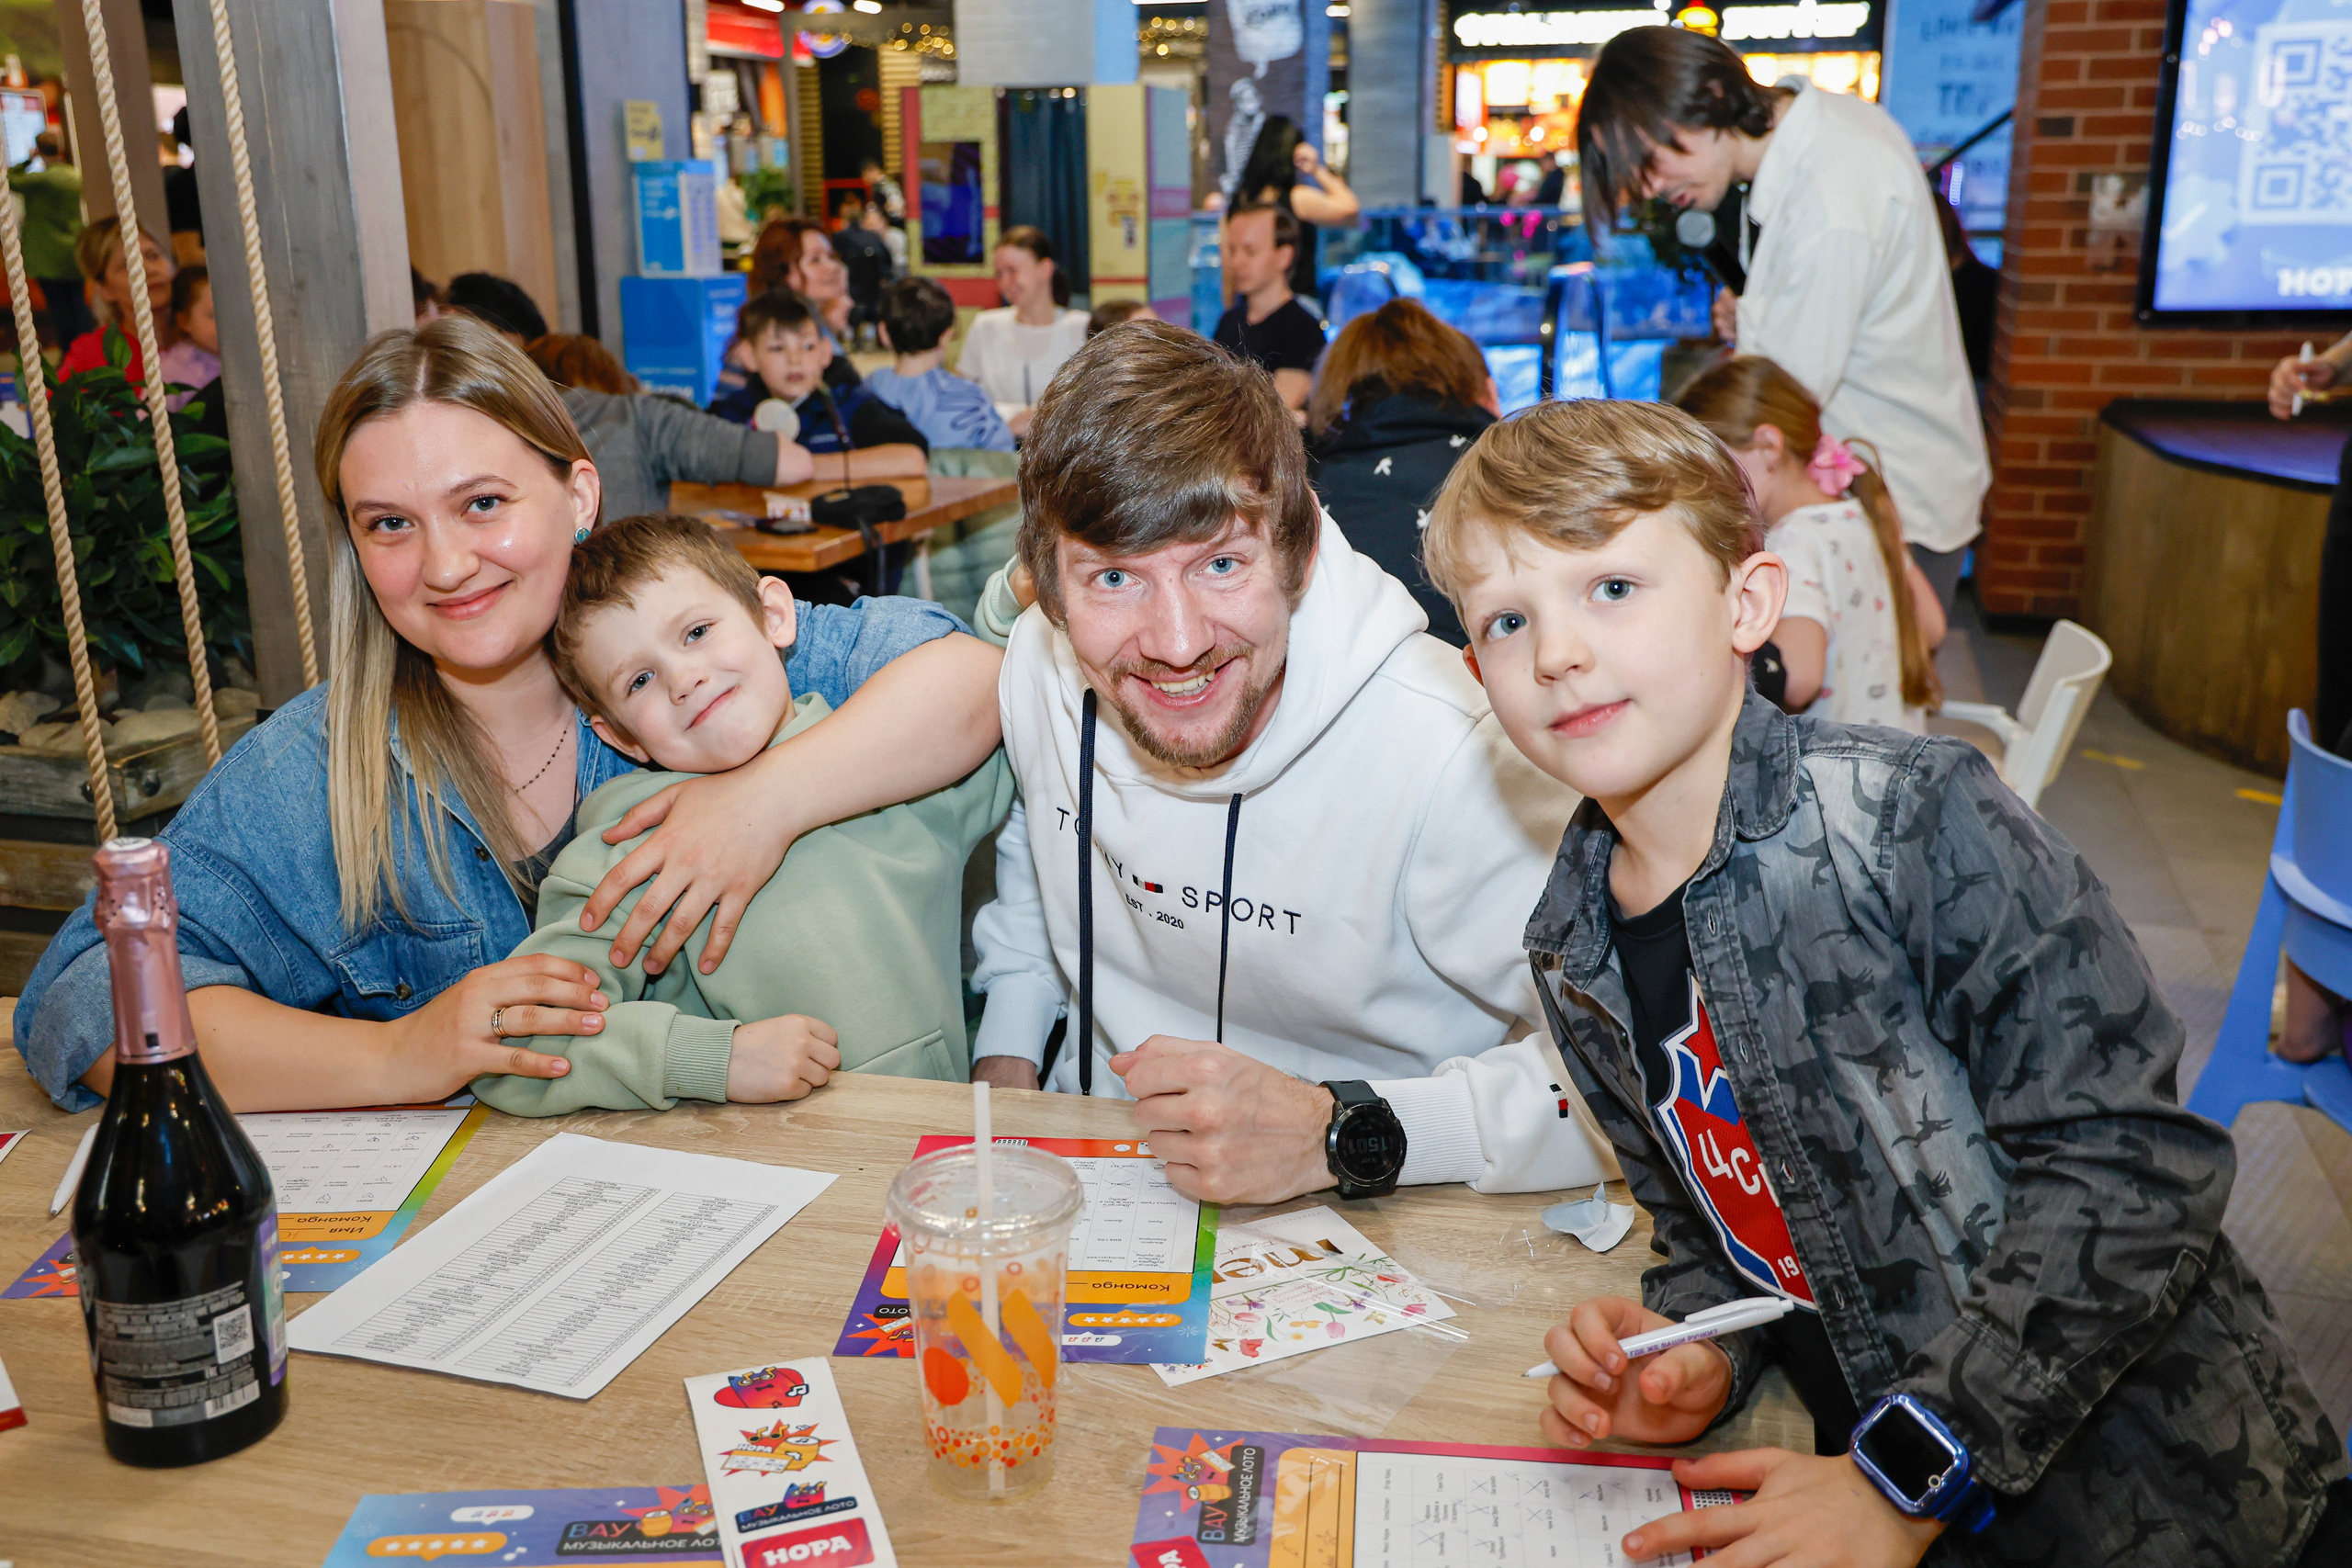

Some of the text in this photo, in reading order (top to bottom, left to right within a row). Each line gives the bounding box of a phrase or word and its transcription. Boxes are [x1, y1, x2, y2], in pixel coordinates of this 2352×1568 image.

[2277, 267, 2352, 297] НОР
[1125, 893, 1144, 914] EST
[1156, 910, 1184, 930] 2020
[1182, 886, 1302, 935] SPORT
[297, 1215, 372, 1224] Команда
[1778, 1256, 1800, 1279] 19
[1091, 1281, 1170, 1292] Команда
[1630, 1348, 1645, 1358] ГДЕ
[1647, 1344, 1660, 1354] ЖЕ
[1662, 1337, 1686, 1350] ВАШИ
[737, 1443, 773, 1453] НОРА
[1233, 1448, 1256, 1543] МУЗЫКАЛЬНОЕ ЛОТО
[740, 1505, 778, 1523] ВАУ
[741, 1500, 854, 1530] МУЗЫКАЛЬНОЕ ЛОТО
[1201, 1506, 1228, 1541] ВАУ
[568, 1521, 631, 1538] ВАУ
[562, 1538, 689, 1551] МУЗЫКАЛЬНОЕ
[763, 1536, 852, 1566] НОРА
